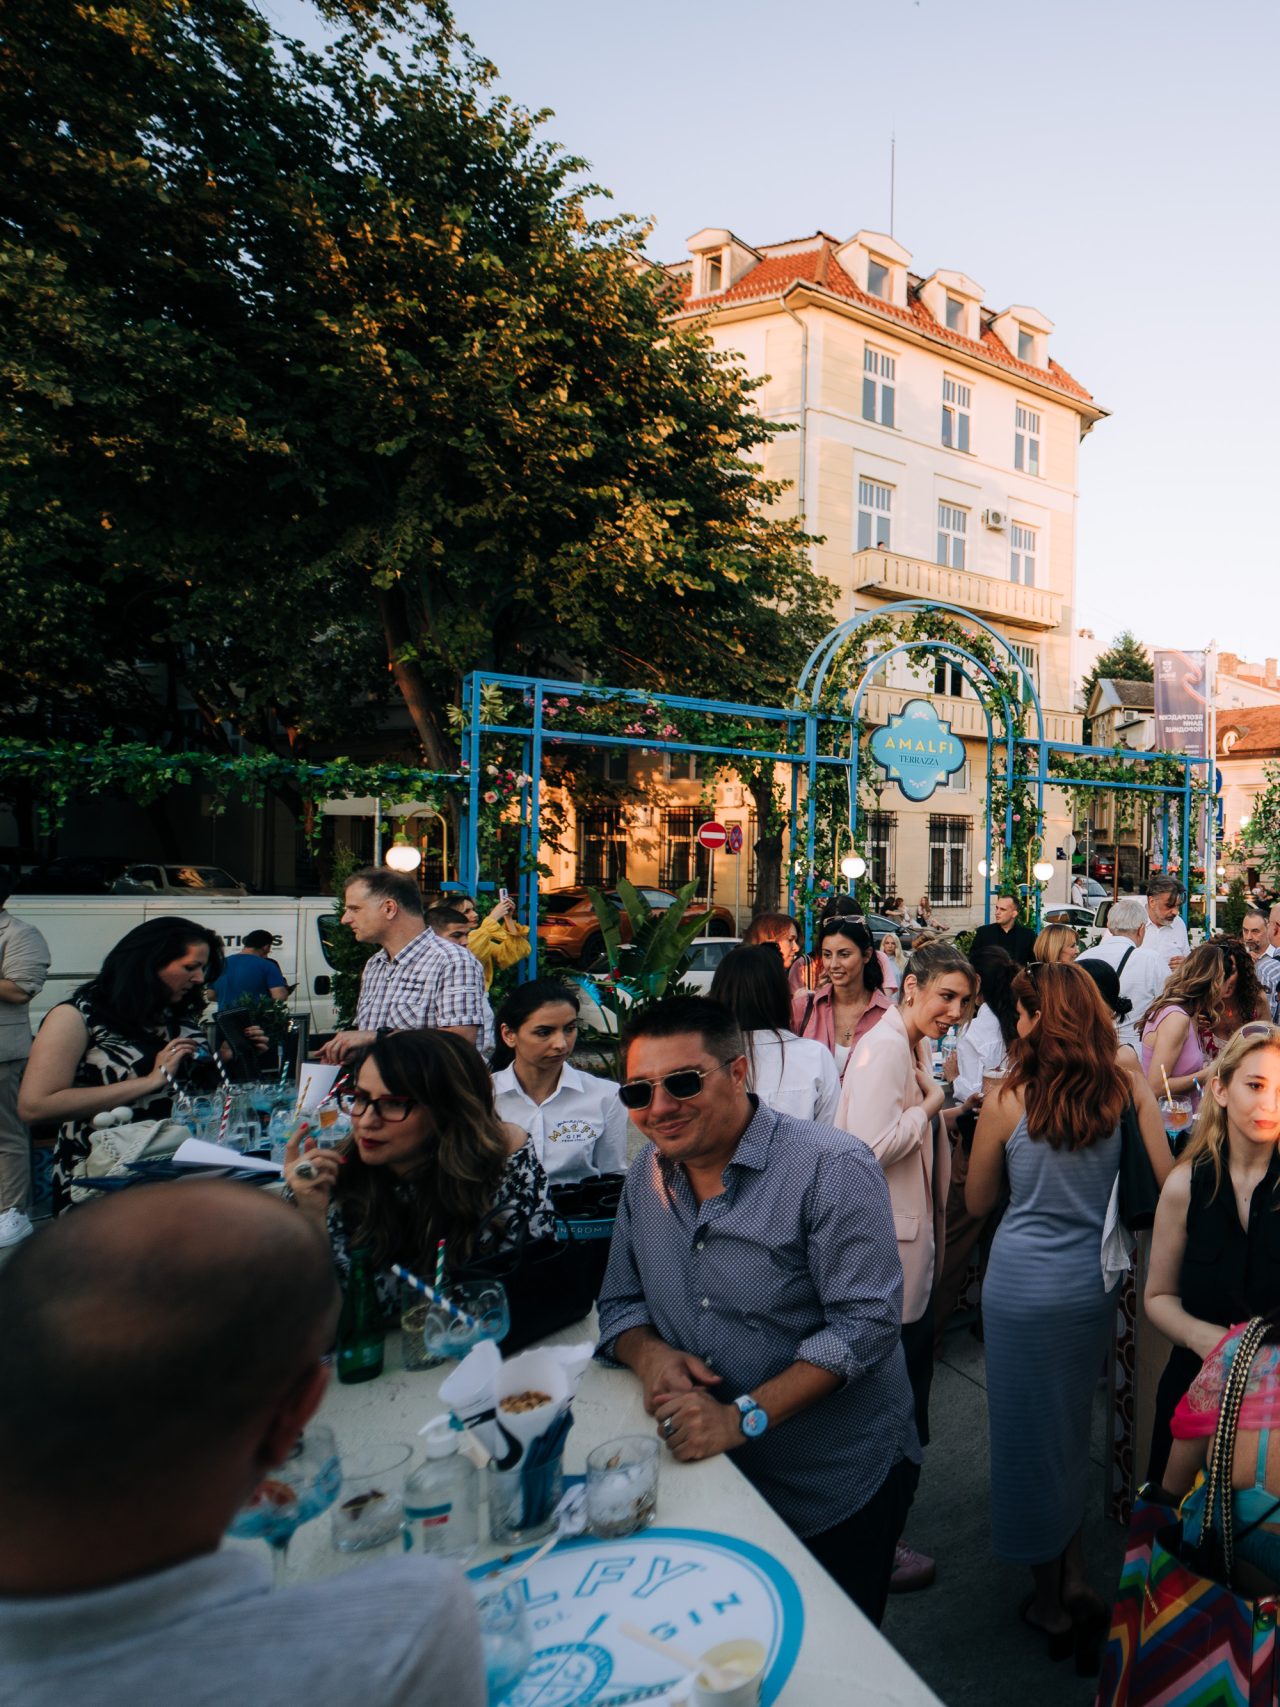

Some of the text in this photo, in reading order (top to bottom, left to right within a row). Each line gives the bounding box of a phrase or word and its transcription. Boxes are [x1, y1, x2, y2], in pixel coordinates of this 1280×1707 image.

[884, 736, 953, 754] AMALFI
[899, 755, 939, 766] TERRAZZA
[504, 1556, 702, 1612] LFY
[650, 1591, 743, 1642] GIN
